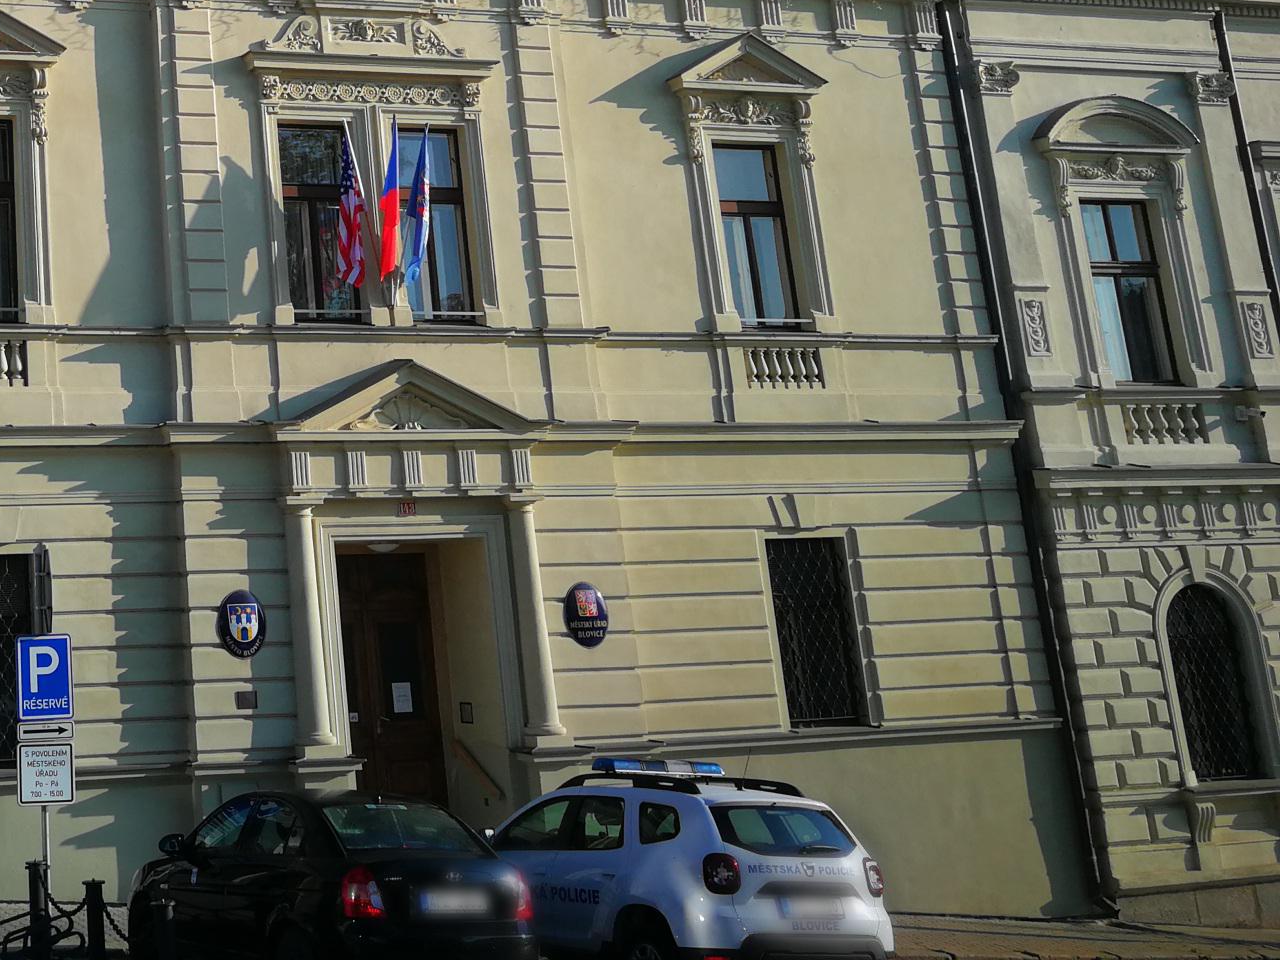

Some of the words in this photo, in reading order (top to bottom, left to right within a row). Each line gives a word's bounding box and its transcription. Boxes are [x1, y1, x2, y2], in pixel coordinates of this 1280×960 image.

[578, 630, 603, 638] BLOVICE
[29, 645, 60, 694] P
[23, 696, 69, 710] RÉSERVÉ
[25, 750, 30, 758] S
[31, 748, 67, 757] POVOLENÍM
[35, 768, 58, 778] ÚŘADU
[35, 780, 44, 788] Po
[50, 780, 59, 788] Pá
[747, 862, 802, 874] MĚSTSKÁ
[550, 885, 600, 905] POLICIE
[791, 920, 841, 931] BLOVICE
